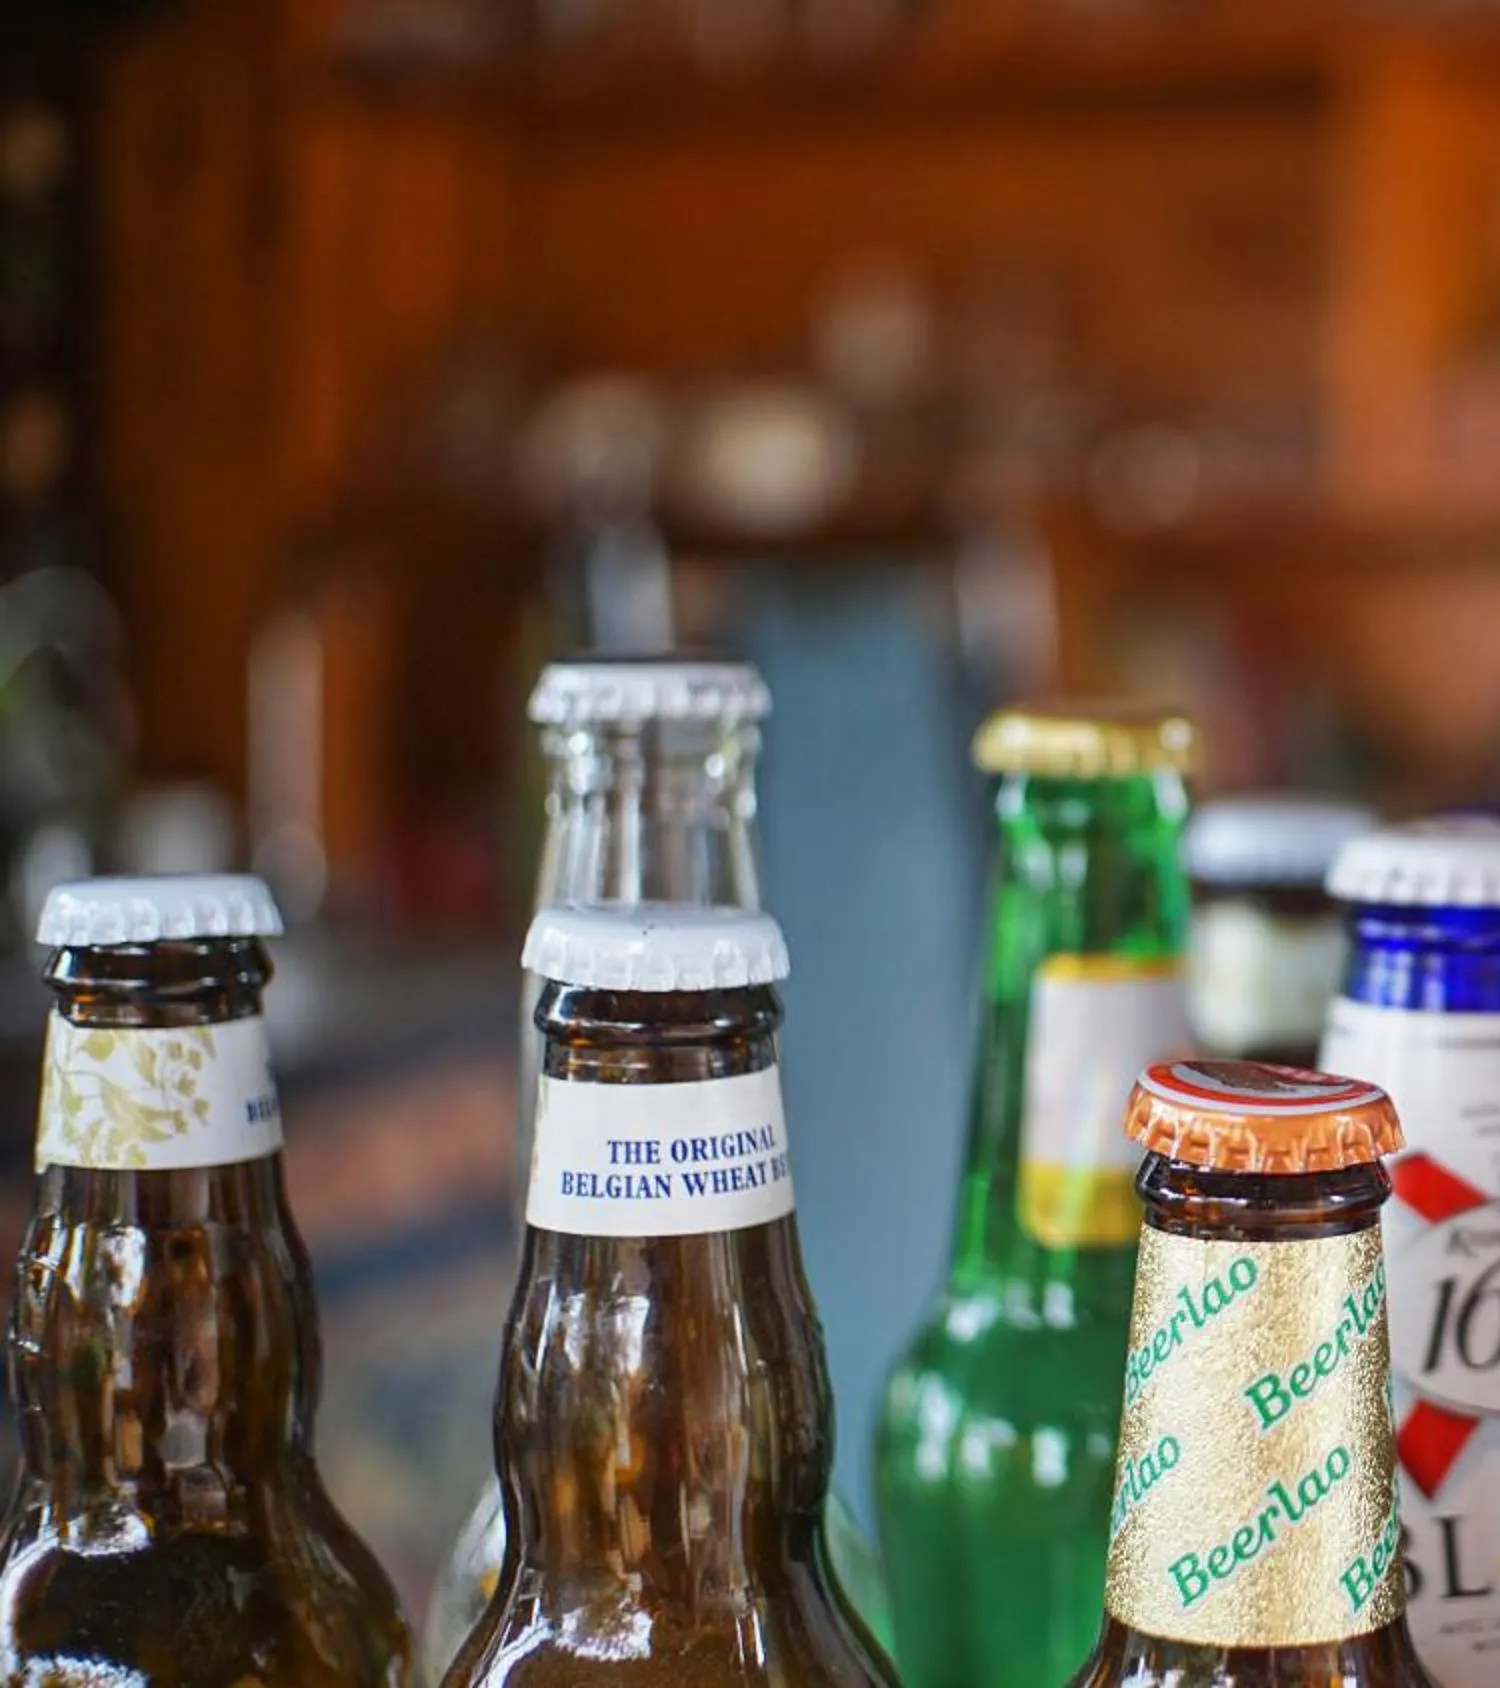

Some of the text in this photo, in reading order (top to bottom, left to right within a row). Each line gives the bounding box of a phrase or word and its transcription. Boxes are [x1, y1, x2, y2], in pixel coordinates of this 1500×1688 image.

[561, 1171, 671, 1199] BELGIAN
[680, 1160, 768, 1198] WHEAT
[606, 1123, 776, 1165] THE ORIGINAL
[1245, 1259, 1386, 1430] Beerlao
[1169, 1446, 1351, 1607] Beerlao
